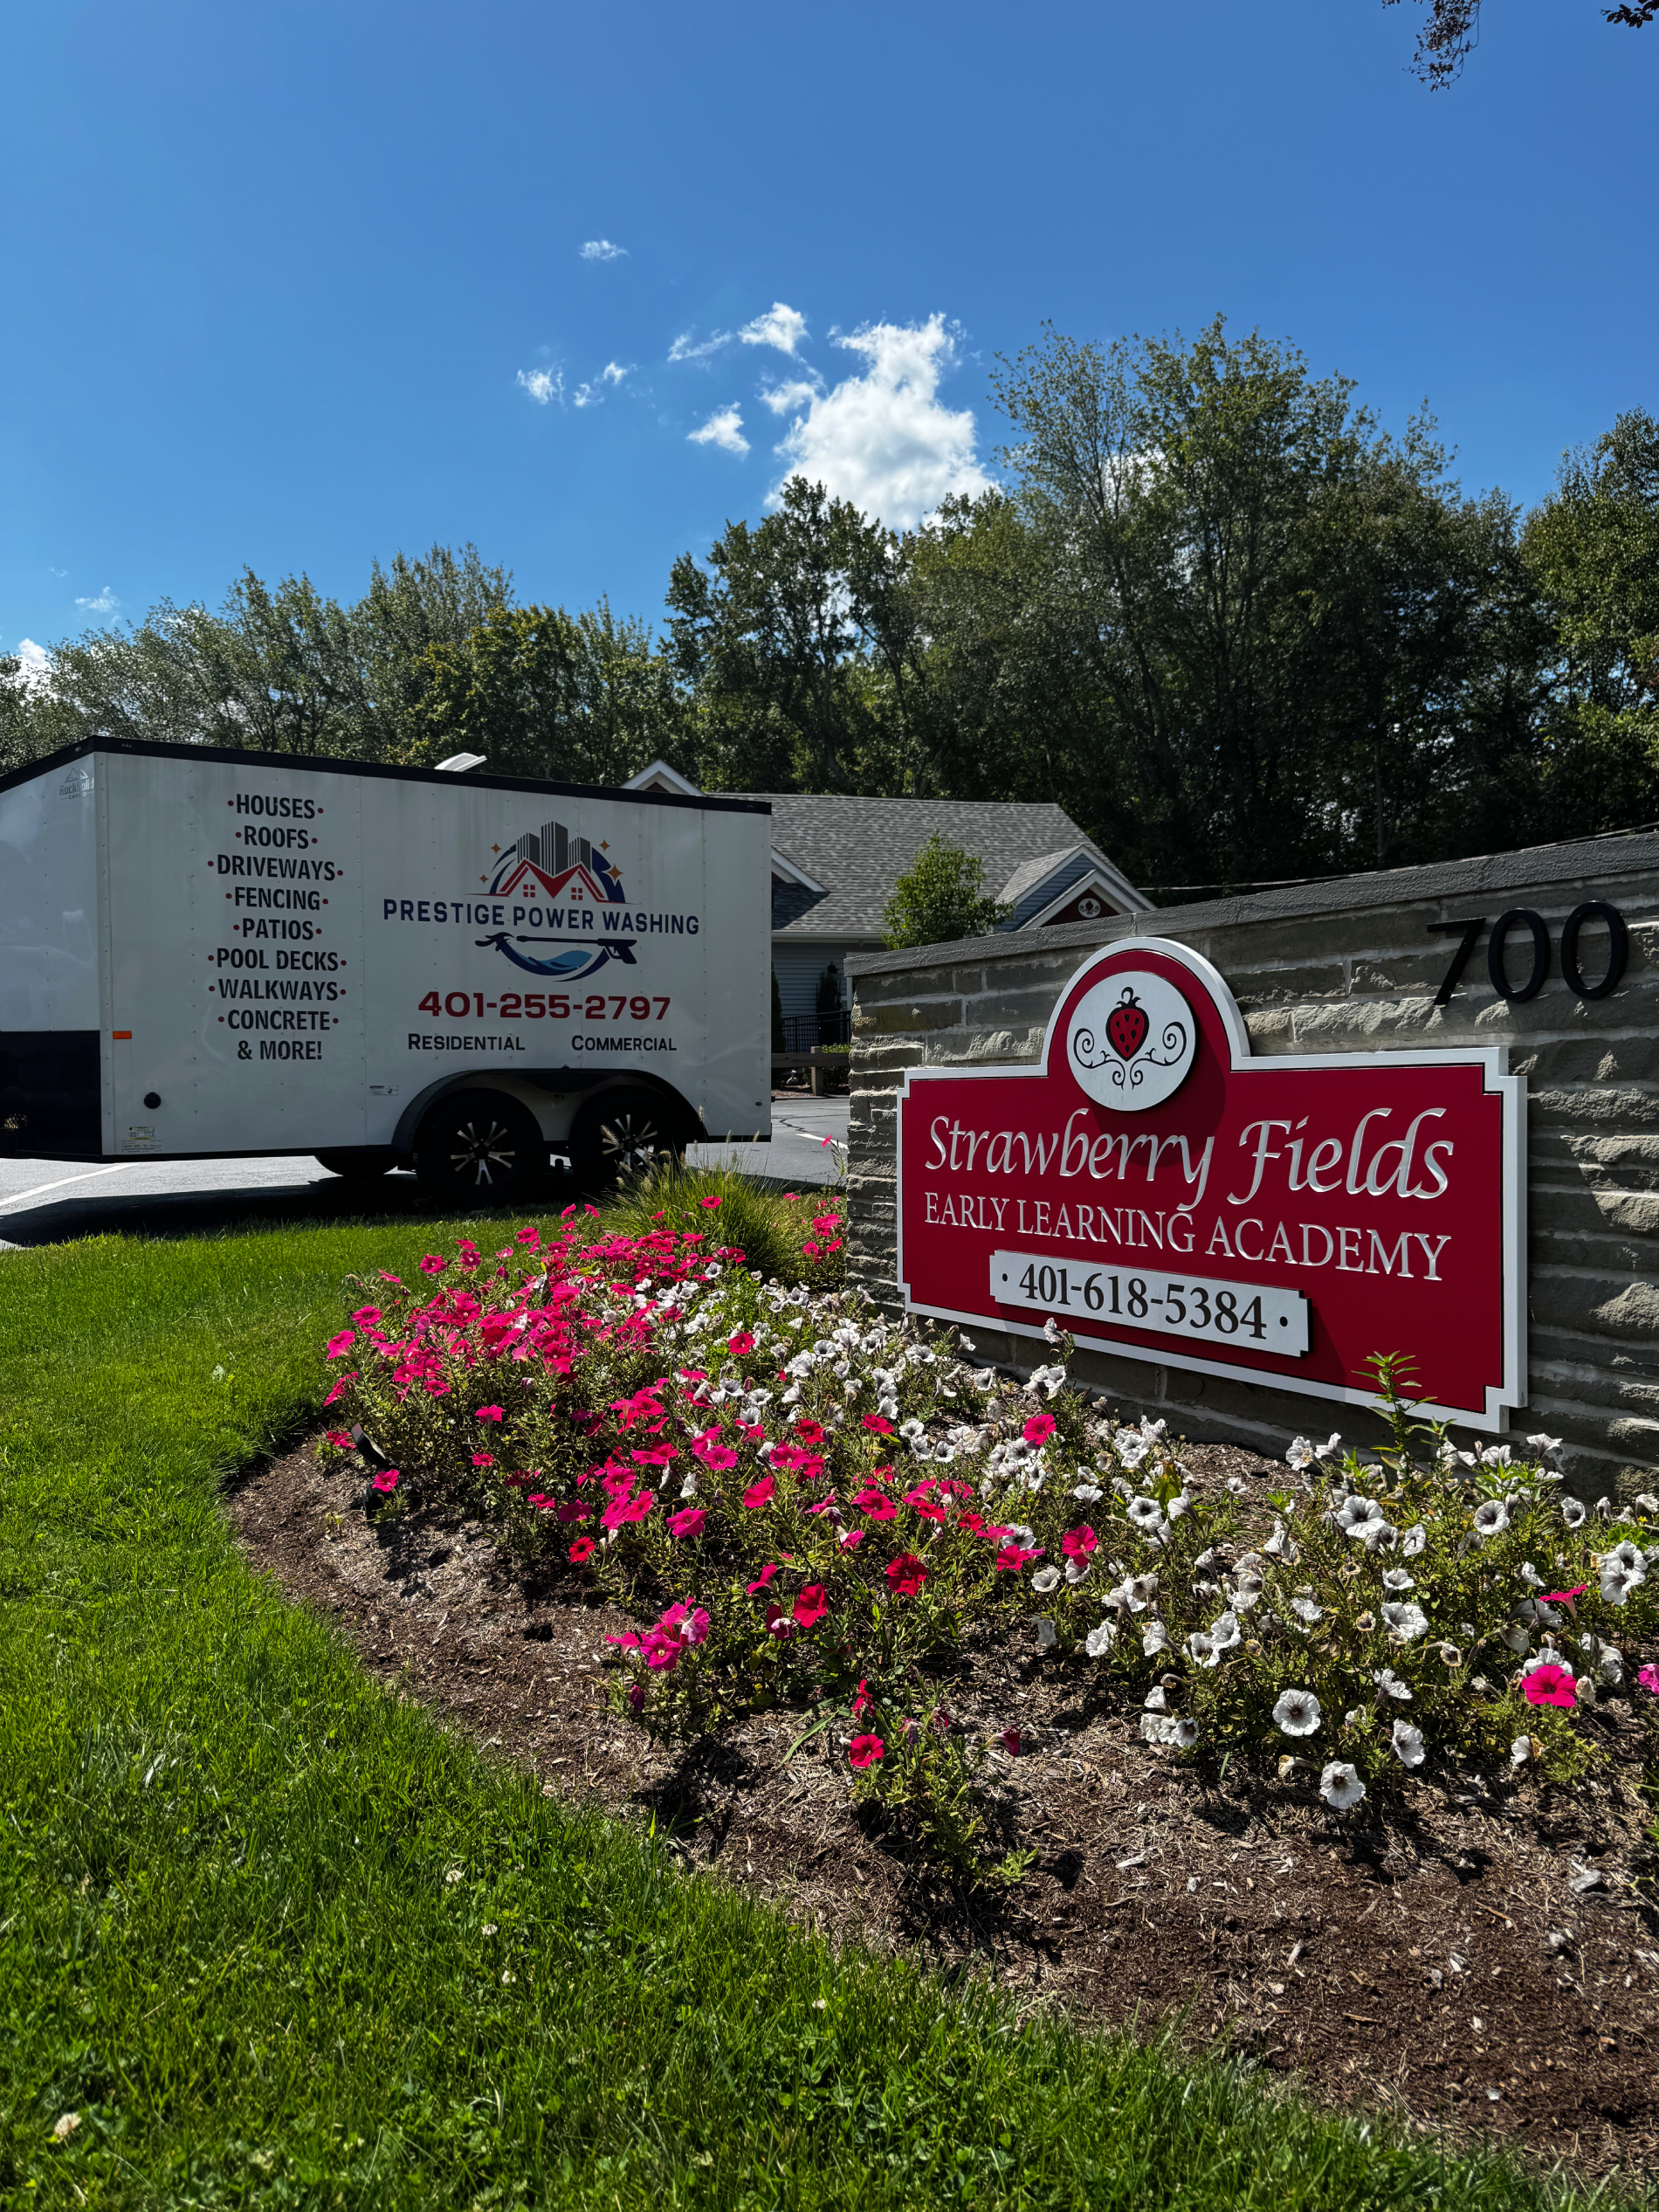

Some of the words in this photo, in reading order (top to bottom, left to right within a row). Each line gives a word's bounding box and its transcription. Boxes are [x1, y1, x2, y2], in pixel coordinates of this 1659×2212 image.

[236, 795, 315, 819] HOUSES
[244, 826, 309, 849] ROOFS
[217, 855, 336, 881] DRIVEWAYS
[234, 887, 320, 910] FENCING
[383, 899, 505, 926] PRESTIGE
[513, 906, 594, 930] POWER
[602, 912, 699, 934] WASHING
[242, 918, 314, 941] PATIOS
[217, 948, 269, 969] POOL
[276, 950, 339, 971] DECKS
[1427, 899, 1628, 1005] 700
[218, 978, 339, 1001] WALKWAYS
[417, 991, 671, 1020] 401-255-2797
[227, 1009, 331, 1030] CONCRETE
[237, 1040, 253, 1060] &
[260, 1039, 322, 1060] MORE!
[407, 1033, 526, 1051] RESIDENTIAL
[571, 1035, 678, 1051] COMMERCIAL
[924, 1107, 1214, 1212] Strawberry
[1228, 1107, 1455, 1205] Fields
[924, 1192, 1009, 1231] EARLY
[1016, 1200, 1194, 1254] LEARNING
[1205, 1216, 1452, 1282] ACADEMY
[1018, 1264, 1268, 1340] 401-618-5384
